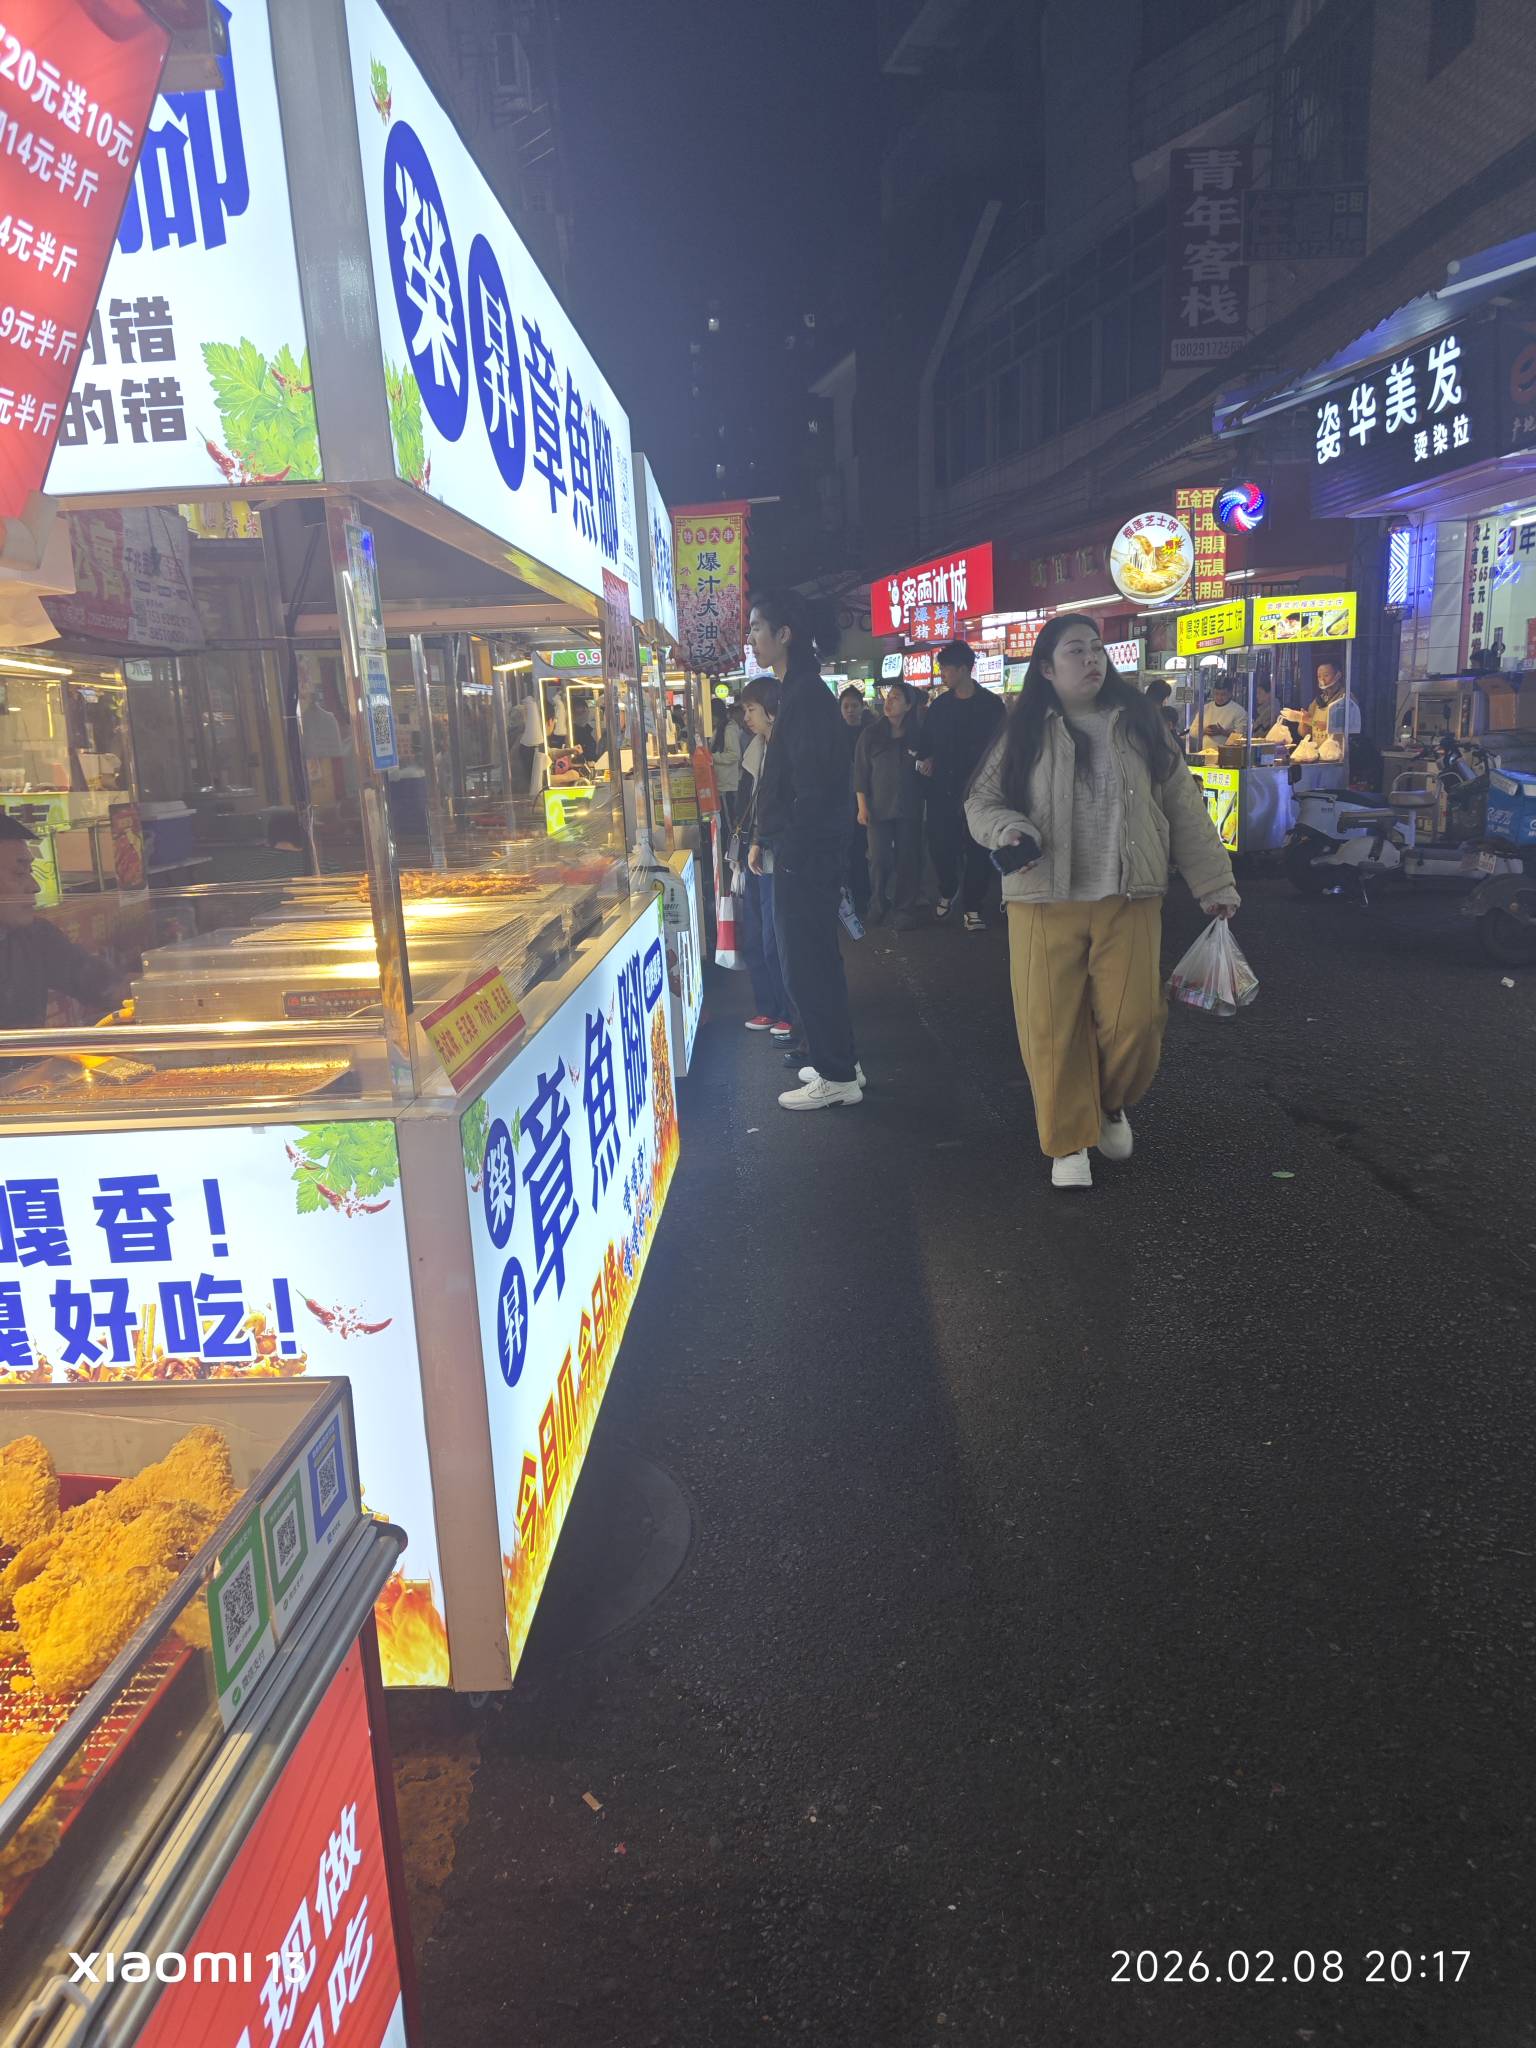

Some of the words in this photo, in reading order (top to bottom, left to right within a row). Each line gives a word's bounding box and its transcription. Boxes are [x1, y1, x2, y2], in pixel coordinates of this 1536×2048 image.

[0, 24, 135, 168] 20元送10元
[1181, 148, 1243, 328] 青年客栈
[1316, 335, 1462, 465] 姿华美发
[1413, 413, 1471, 463] 烫染拉
[1122, 514, 1180, 538] 榴莲芝士饼
[1176, 489, 1221, 509] 五金百
[696, 551, 722, 663] 爆汁大油边
[913, 622, 951, 639] 猪蹄
